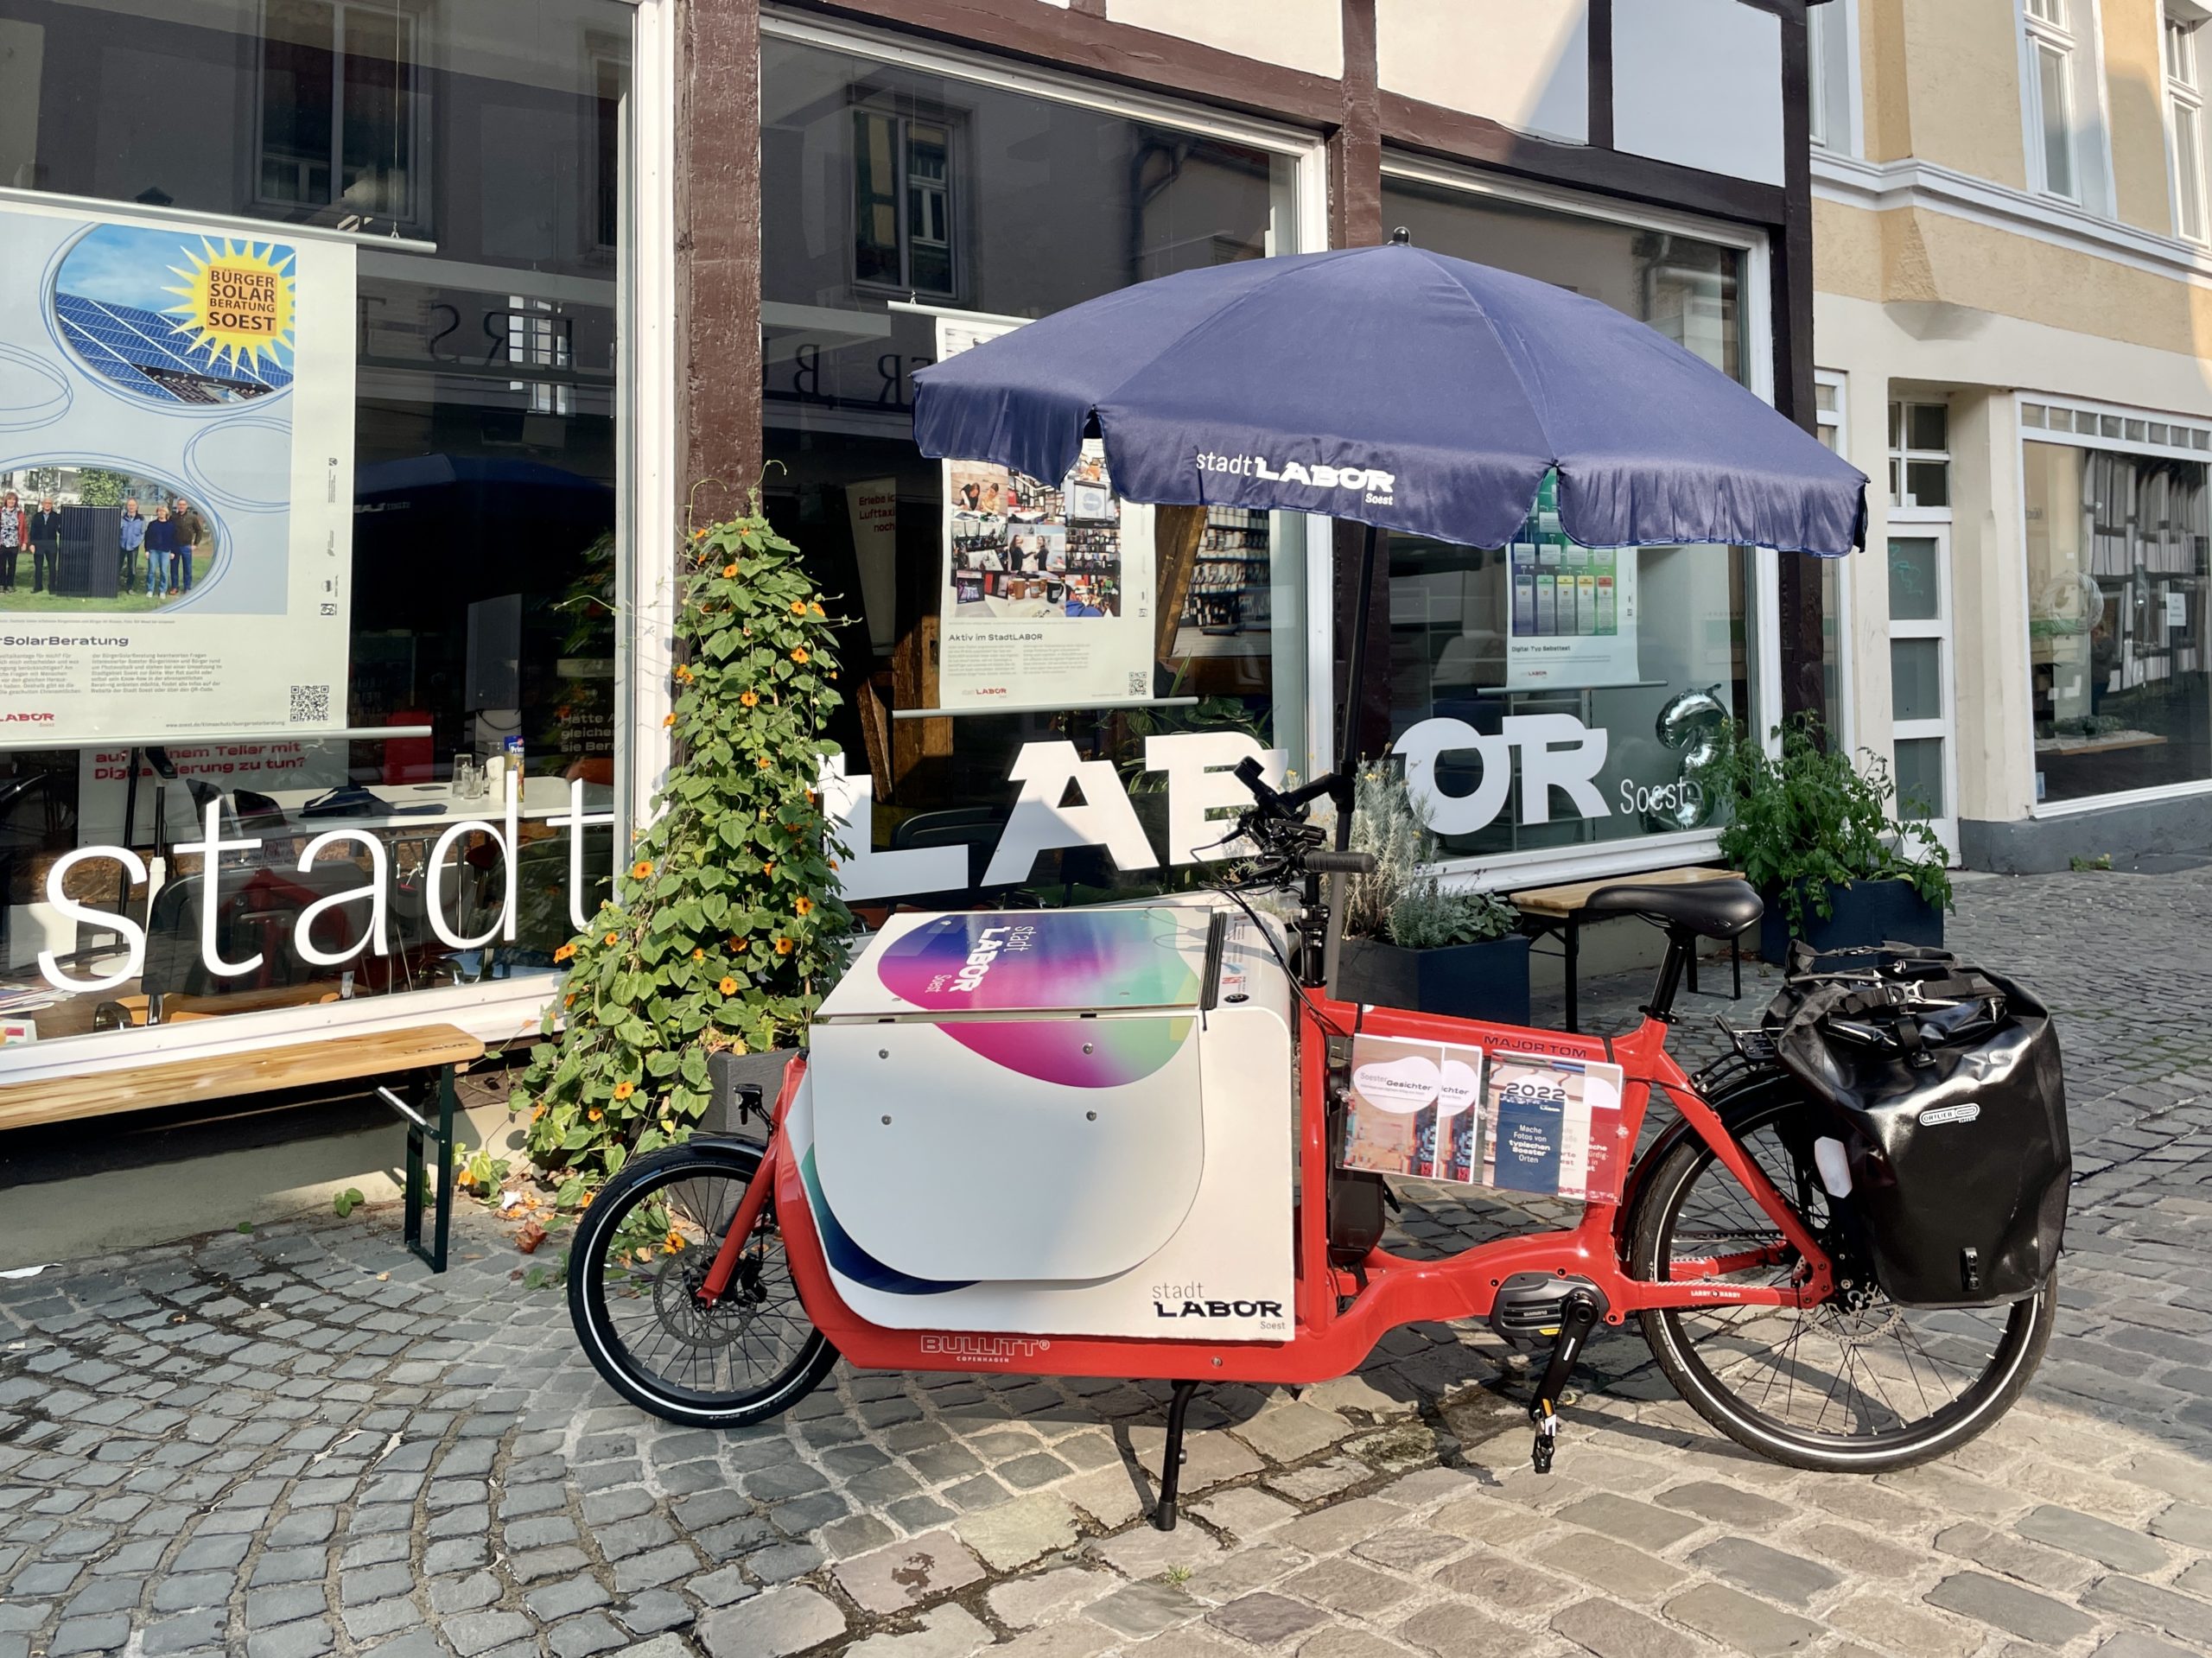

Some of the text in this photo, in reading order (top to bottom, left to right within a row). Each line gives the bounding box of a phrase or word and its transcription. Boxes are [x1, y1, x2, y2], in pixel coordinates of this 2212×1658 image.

[211, 270, 274, 288] BÜRGER
[211, 283, 275, 302] SOLAR
[210, 298, 275, 313] BERATUNG
[209, 311, 276, 331] SOEST
[1196, 451, 1395, 492] stadt LABOR
[1365, 492, 1393, 505] Soest
[561, 727, 614, 740] gleiche
[215, 745, 268, 756] Teller
[271, 741, 301, 753] mit
[238, 759, 261, 771] zu
[265, 757, 305, 769] tun?
[37, 770, 614, 993] stadt
[1620, 776, 1687, 815] Soest
[1003, 926, 1037, 952] stadt
[949, 926, 1011, 993] LABOR
[925, 974, 952, 994] Soest
[1484, 1036, 1586, 1058] MAJOR TOM
[1360, 1072, 1387, 1083] Soester
[1386, 1079, 1433, 1091] Gesichter
[1506, 1083, 1566, 1101] 2022
[1514, 1132, 1533, 1140] Fotos
[1519, 1124, 1542, 1134] Mache
[1509, 1140, 1551, 1151] typischen
[1512, 1147, 1547, 1156] Soester
[1519, 1154, 1539, 1164] Orten
[1152, 1280, 1205, 1299] stadt
[1154, 1300, 1283, 1318] LABOR
[1260, 1321, 1286, 1330] Soest
